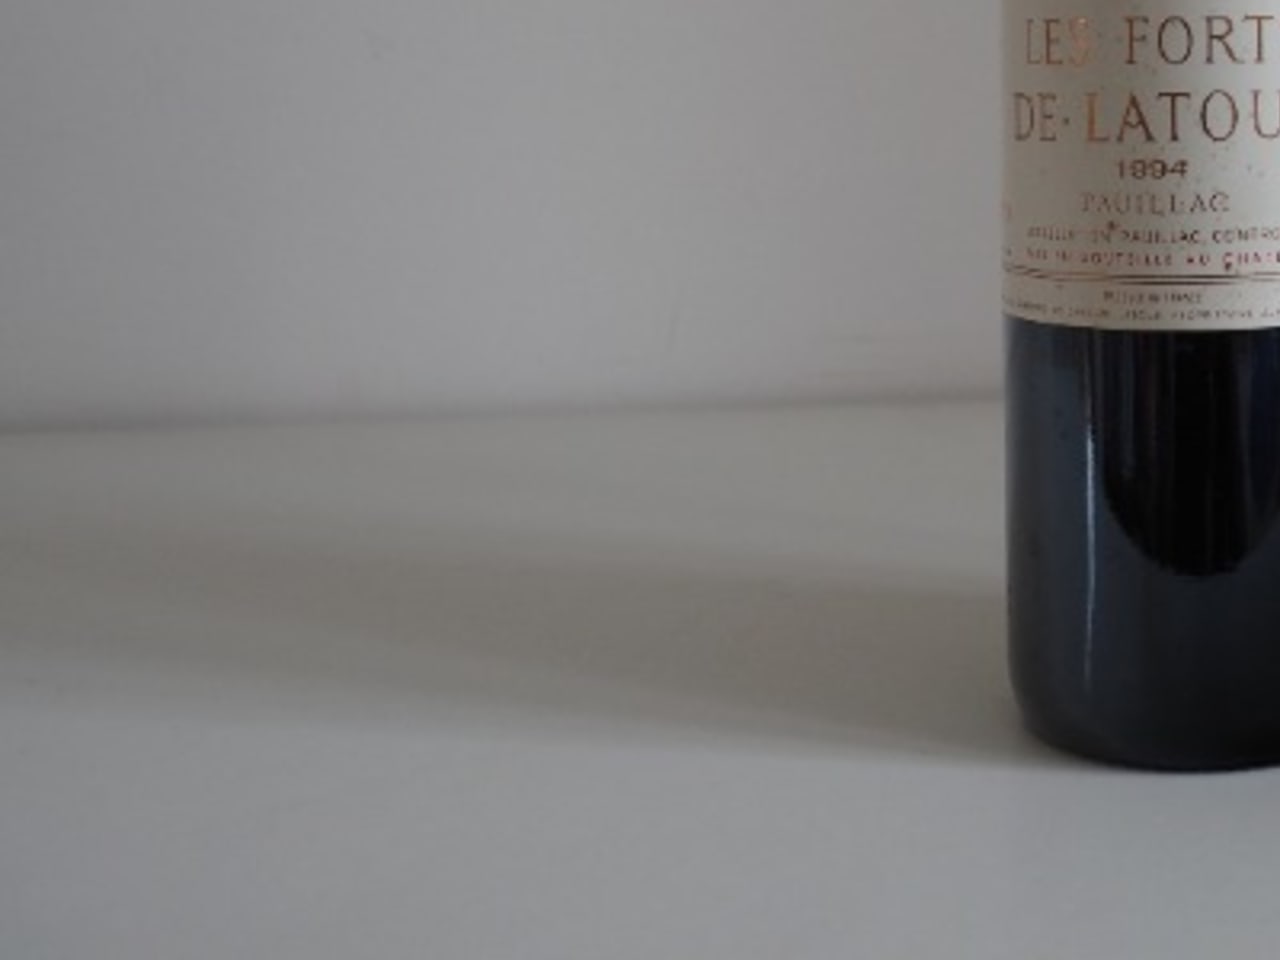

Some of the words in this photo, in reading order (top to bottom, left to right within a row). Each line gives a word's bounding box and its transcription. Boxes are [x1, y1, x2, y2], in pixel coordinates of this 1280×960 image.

[1025, 16, 1090, 67] LES
[1115, 158, 1190, 180] 1994
[1080, 191, 1231, 215] PAUILLAC
